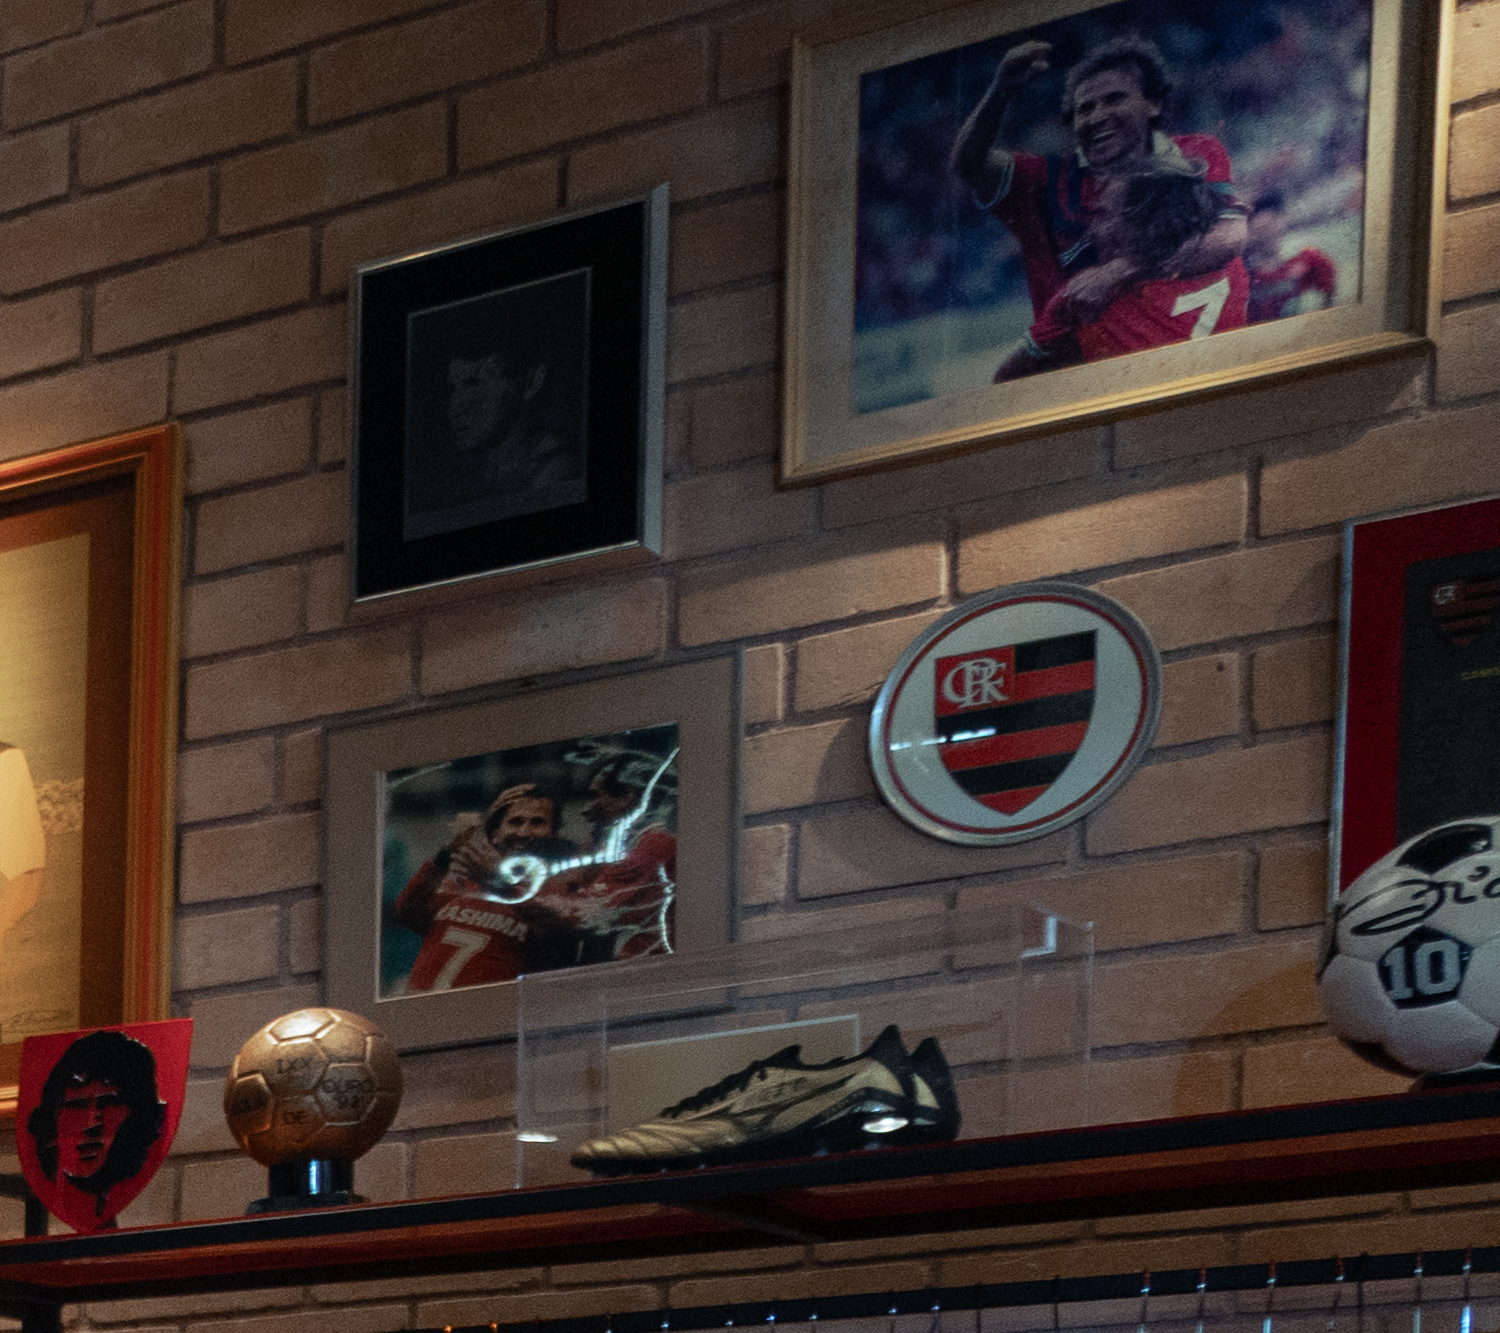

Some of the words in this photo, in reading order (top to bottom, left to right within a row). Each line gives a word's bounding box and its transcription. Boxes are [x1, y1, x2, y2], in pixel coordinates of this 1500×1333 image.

[1171, 278, 1231, 340] 7
[430, 926, 491, 991] 7
[1383, 939, 1462, 999] 10
